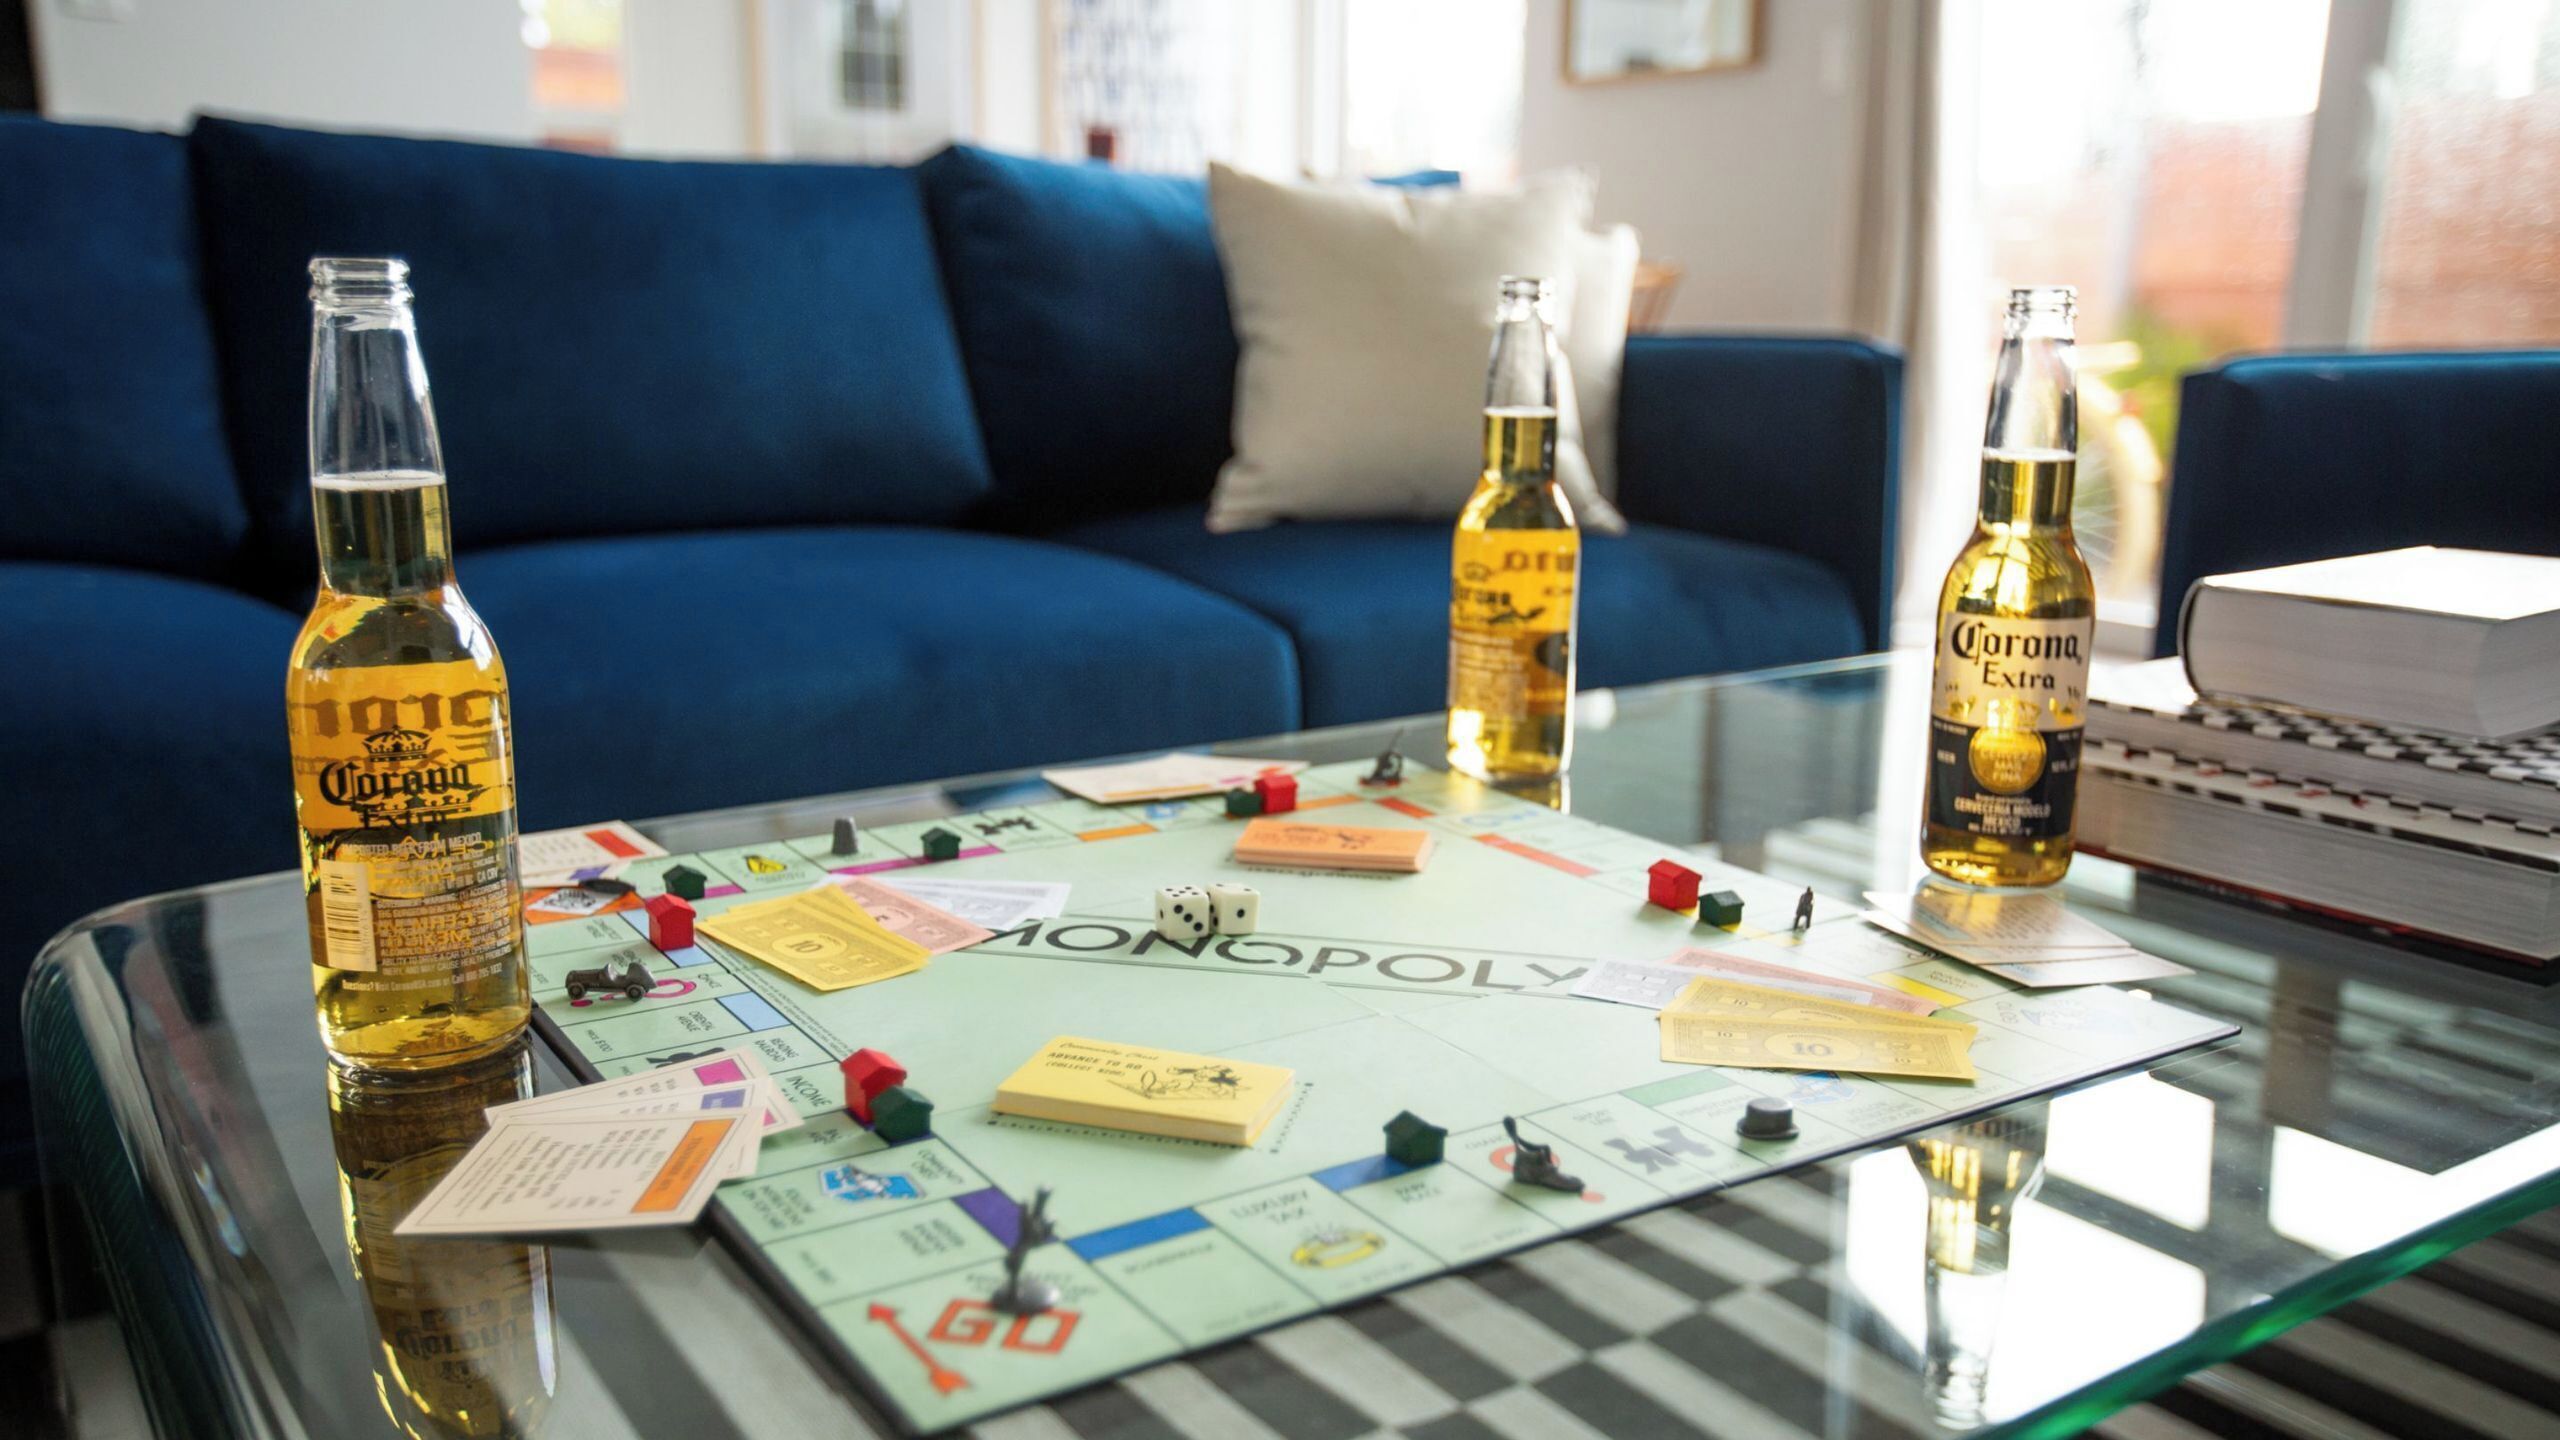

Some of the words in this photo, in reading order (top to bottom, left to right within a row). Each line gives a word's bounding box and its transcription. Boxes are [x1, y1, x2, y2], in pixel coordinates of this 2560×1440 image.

[1951, 619, 2080, 666] Corona
[1983, 660, 2055, 690] Extra
[318, 760, 470, 808] Corona
[981, 921, 1589, 991] MONOPOLY
[1047, 1051, 1101, 1065] ADVANCE
[1106, 1059, 1121, 1067] TO
[1790, 1042, 1834, 1058] 10
[785, 1074, 833, 1108] INCOME
[1229, 1189, 1312, 1220] LUXURY
[1267, 1206, 1311, 1226] TAX
[928, 1298, 1083, 1357] GO
